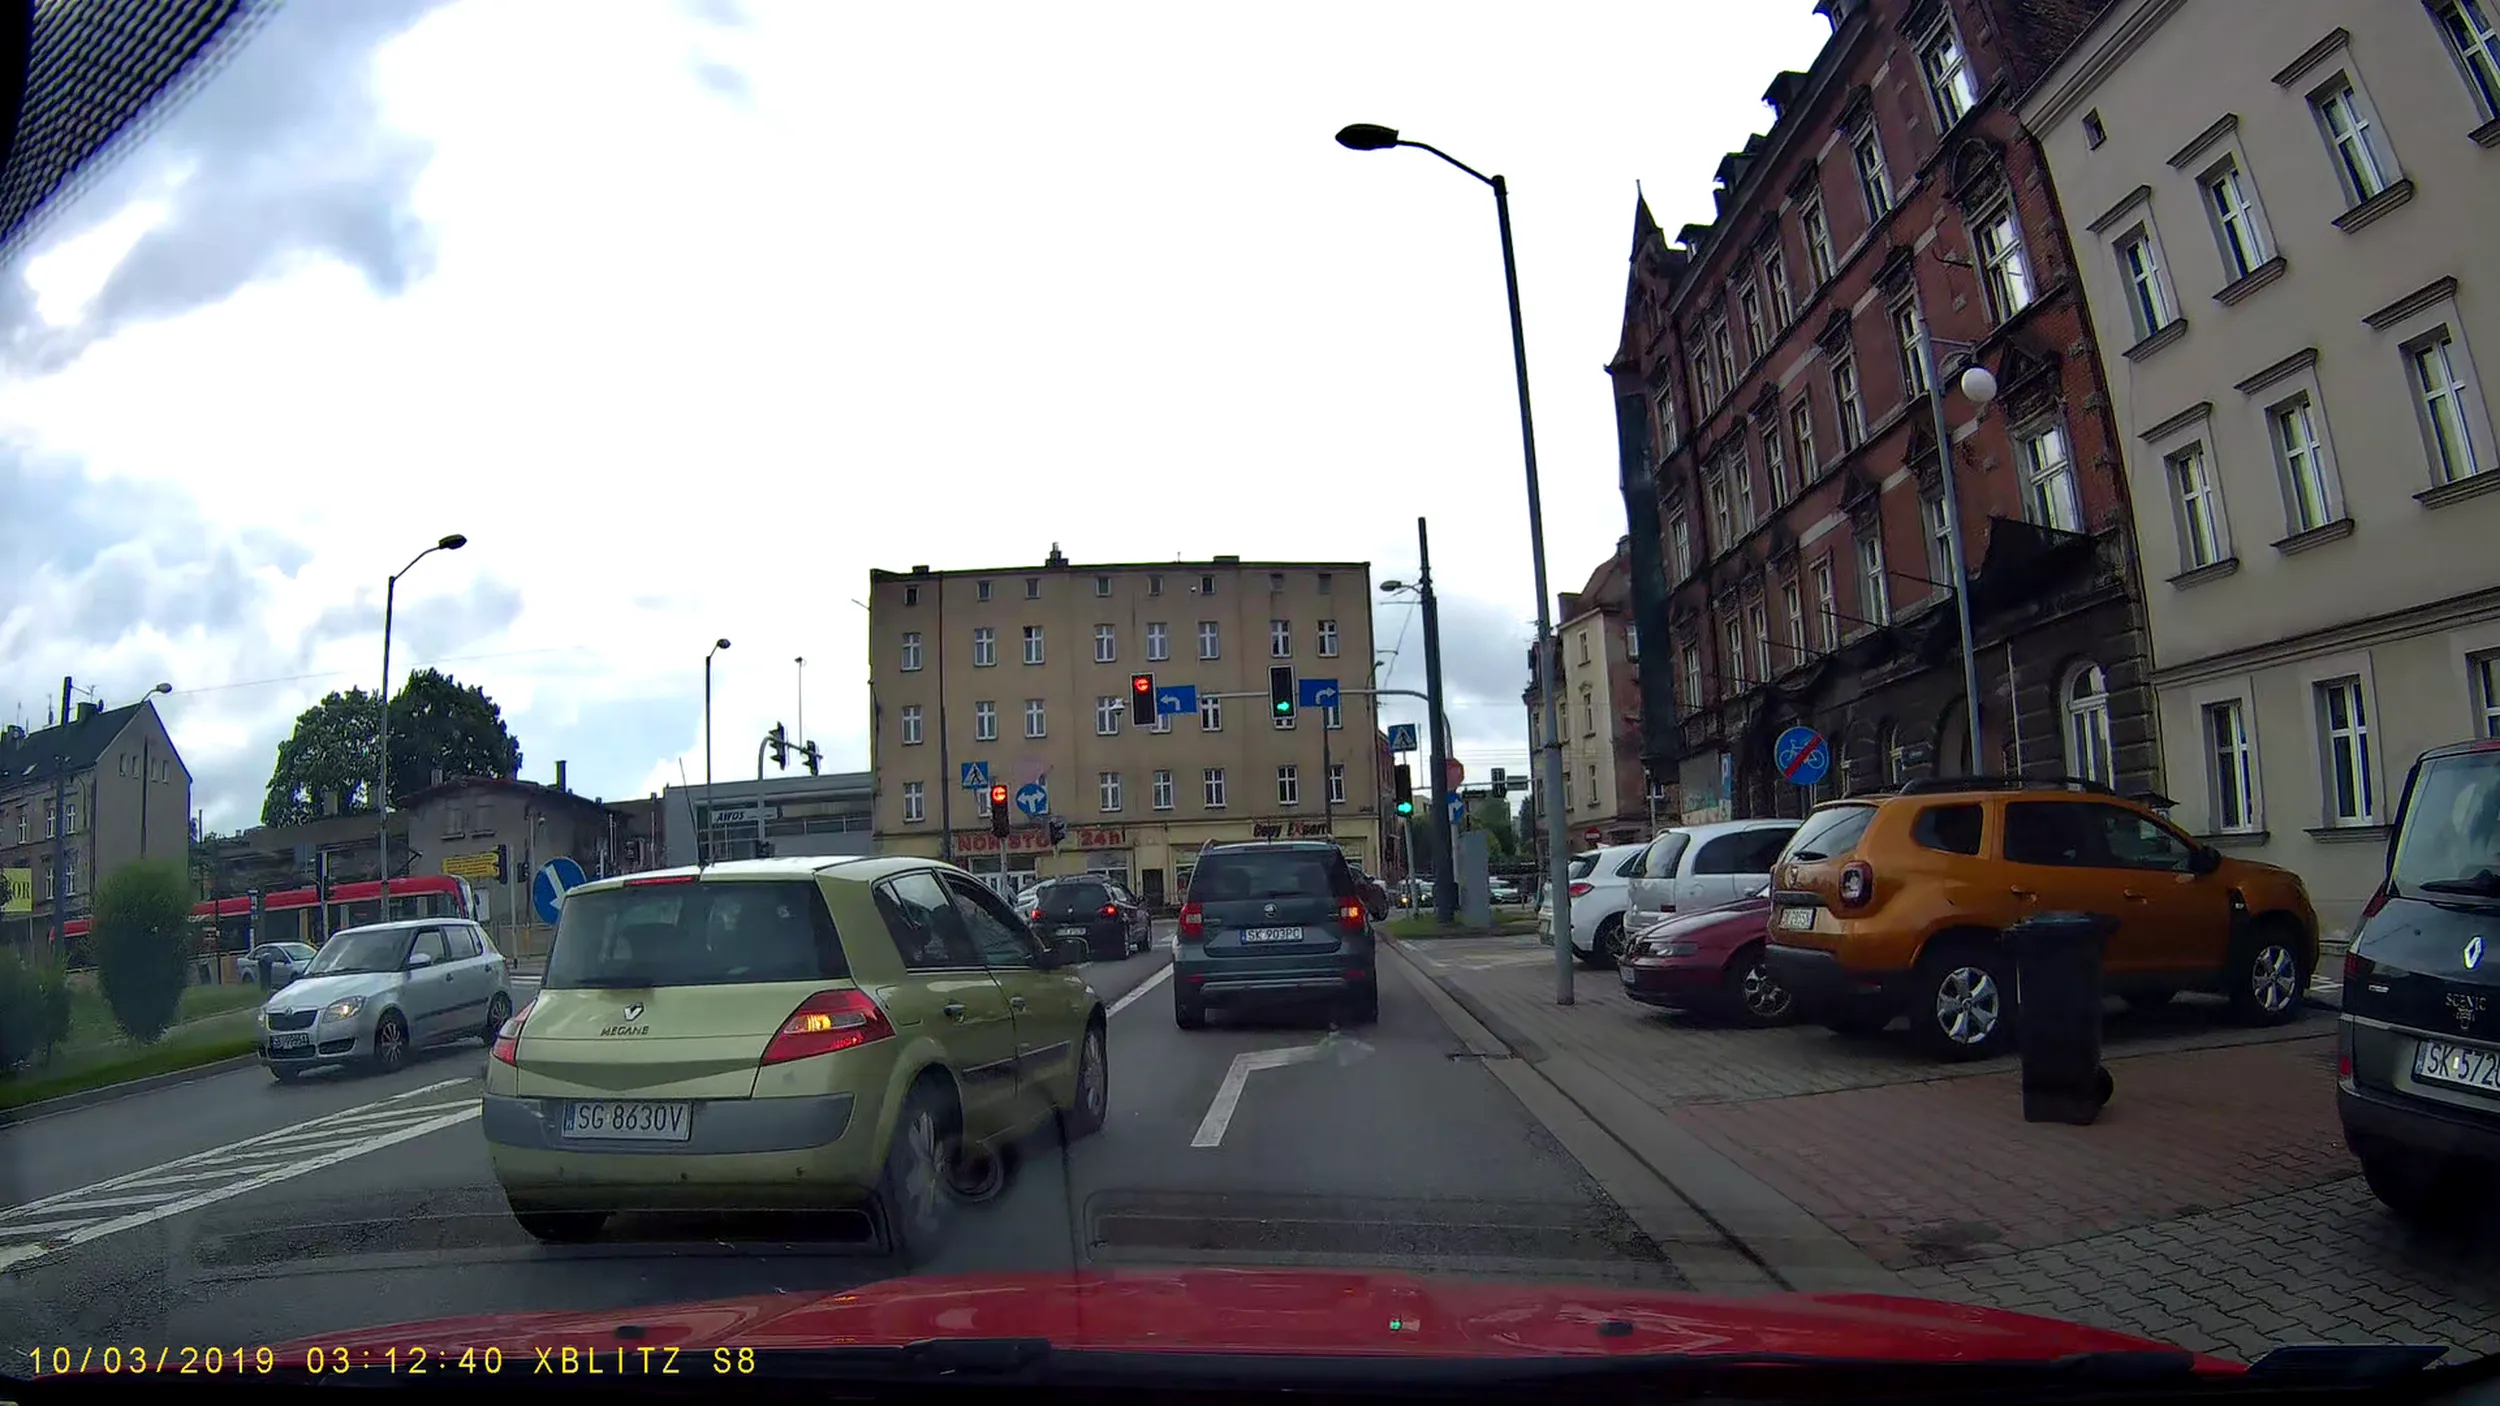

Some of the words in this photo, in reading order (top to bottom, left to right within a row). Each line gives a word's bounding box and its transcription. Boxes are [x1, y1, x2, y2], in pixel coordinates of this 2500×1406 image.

[1248, 929, 1262, 941] SK
[601, 1026, 649, 1037] MEGANE
[2427, 1044, 2455, 1077] SK
[578, 1104, 605, 1130] SG
[612, 1104, 684, 1131] 8630V
